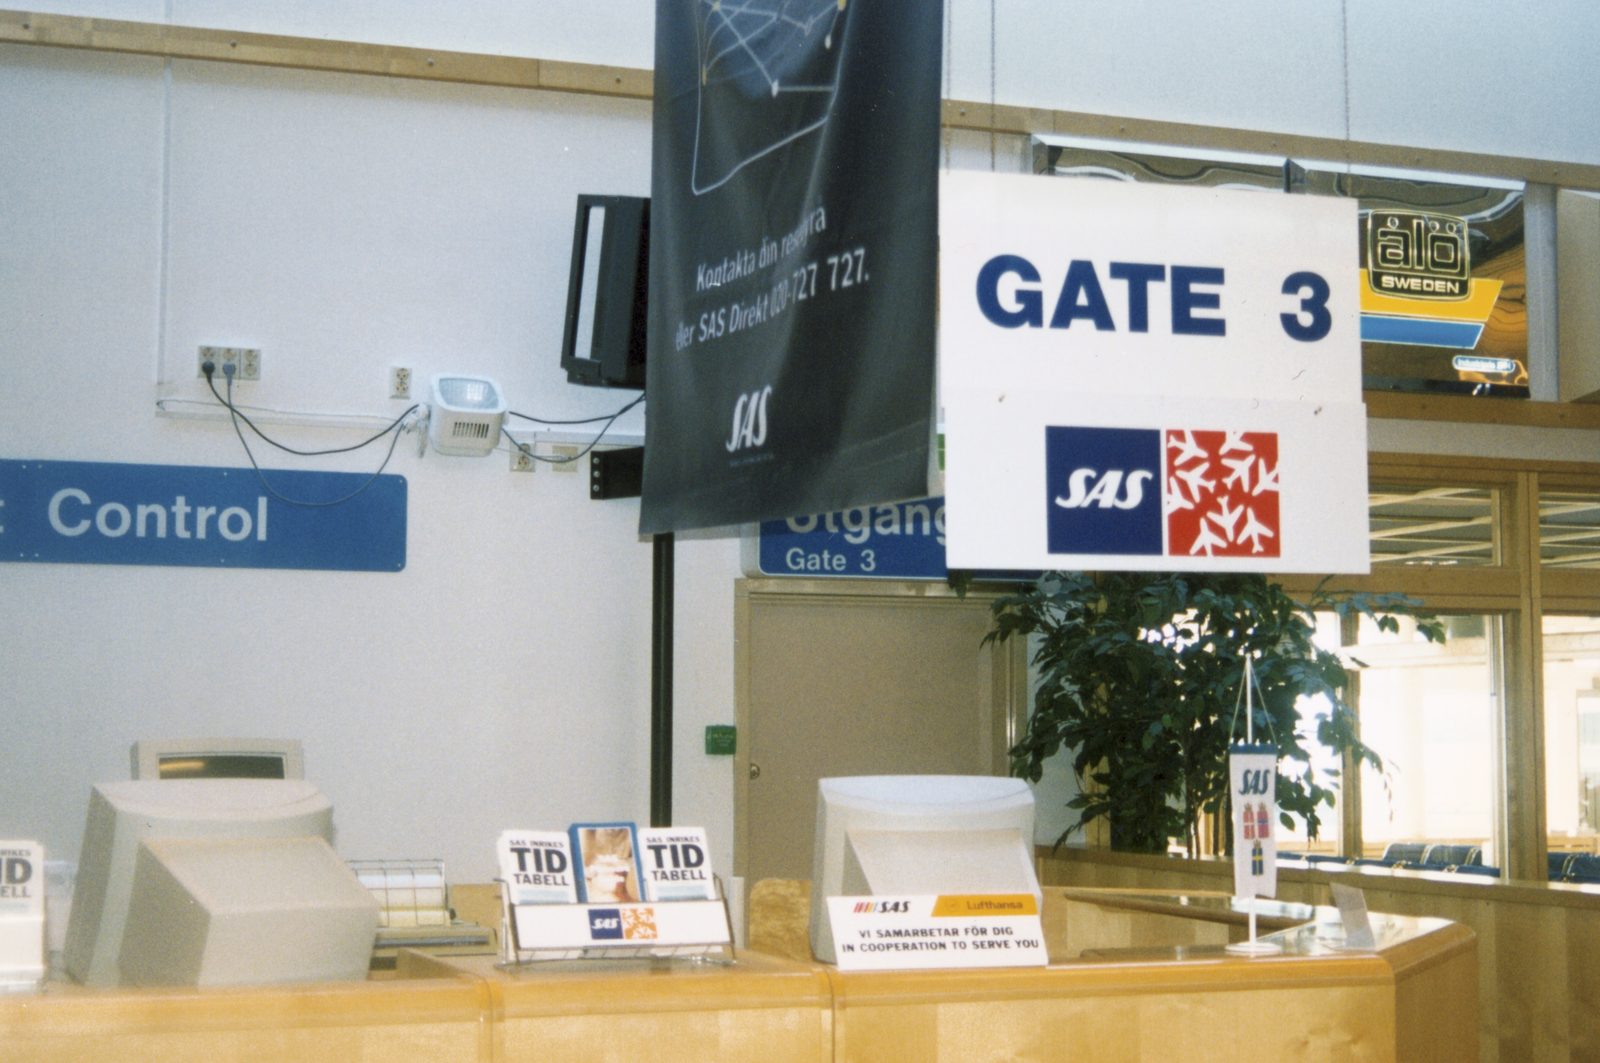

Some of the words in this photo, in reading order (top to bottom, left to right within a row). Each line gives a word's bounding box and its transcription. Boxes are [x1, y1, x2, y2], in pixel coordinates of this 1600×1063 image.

[696, 249, 755, 291] Kontakta
[758, 236, 778, 270] din
[698, 303, 726, 343] SAS
[729, 291, 768, 334] Direkt
[827, 247, 869, 291] 727.
[1381, 275, 1460, 294] SWEDEN
[976, 254, 1226, 337] GATE
[1280, 271, 1332, 342] 3
[726, 384, 772, 452] SAS
[1055, 467, 1153, 510] SAS
[48, 487, 268, 541] Control
[785, 547, 847, 571] Gate
[860, 549, 876, 572] 3
[1238, 769, 1271, 796] SAS
[530, 840, 564, 848] INRIKES
[647, 843, 704, 869] TID
[510, 847, 567, 873] TID
[513, 873, 570, 886] TABELL
[651, 869, 707, 882] TABELL
[879, 901, 911, 913] SAS
[966, 900, 1023, 910] Lufthansa
[591, 917, 619, 930] SAS
[858, 930, 871, 939] VI
[876, 927, 960, 939] SAMARBETAR
[964, 926, 988, 937] FÖR
[993, 926, 1014, 936] DIG
[842, 943, 855, 953] IN
[860, 942, 947, 952] COOPERATION
[952, 941, 967, 950] TO
[972, 940, 1010, 950] SERVE
[1016, 939, 1039, 949] YOU
